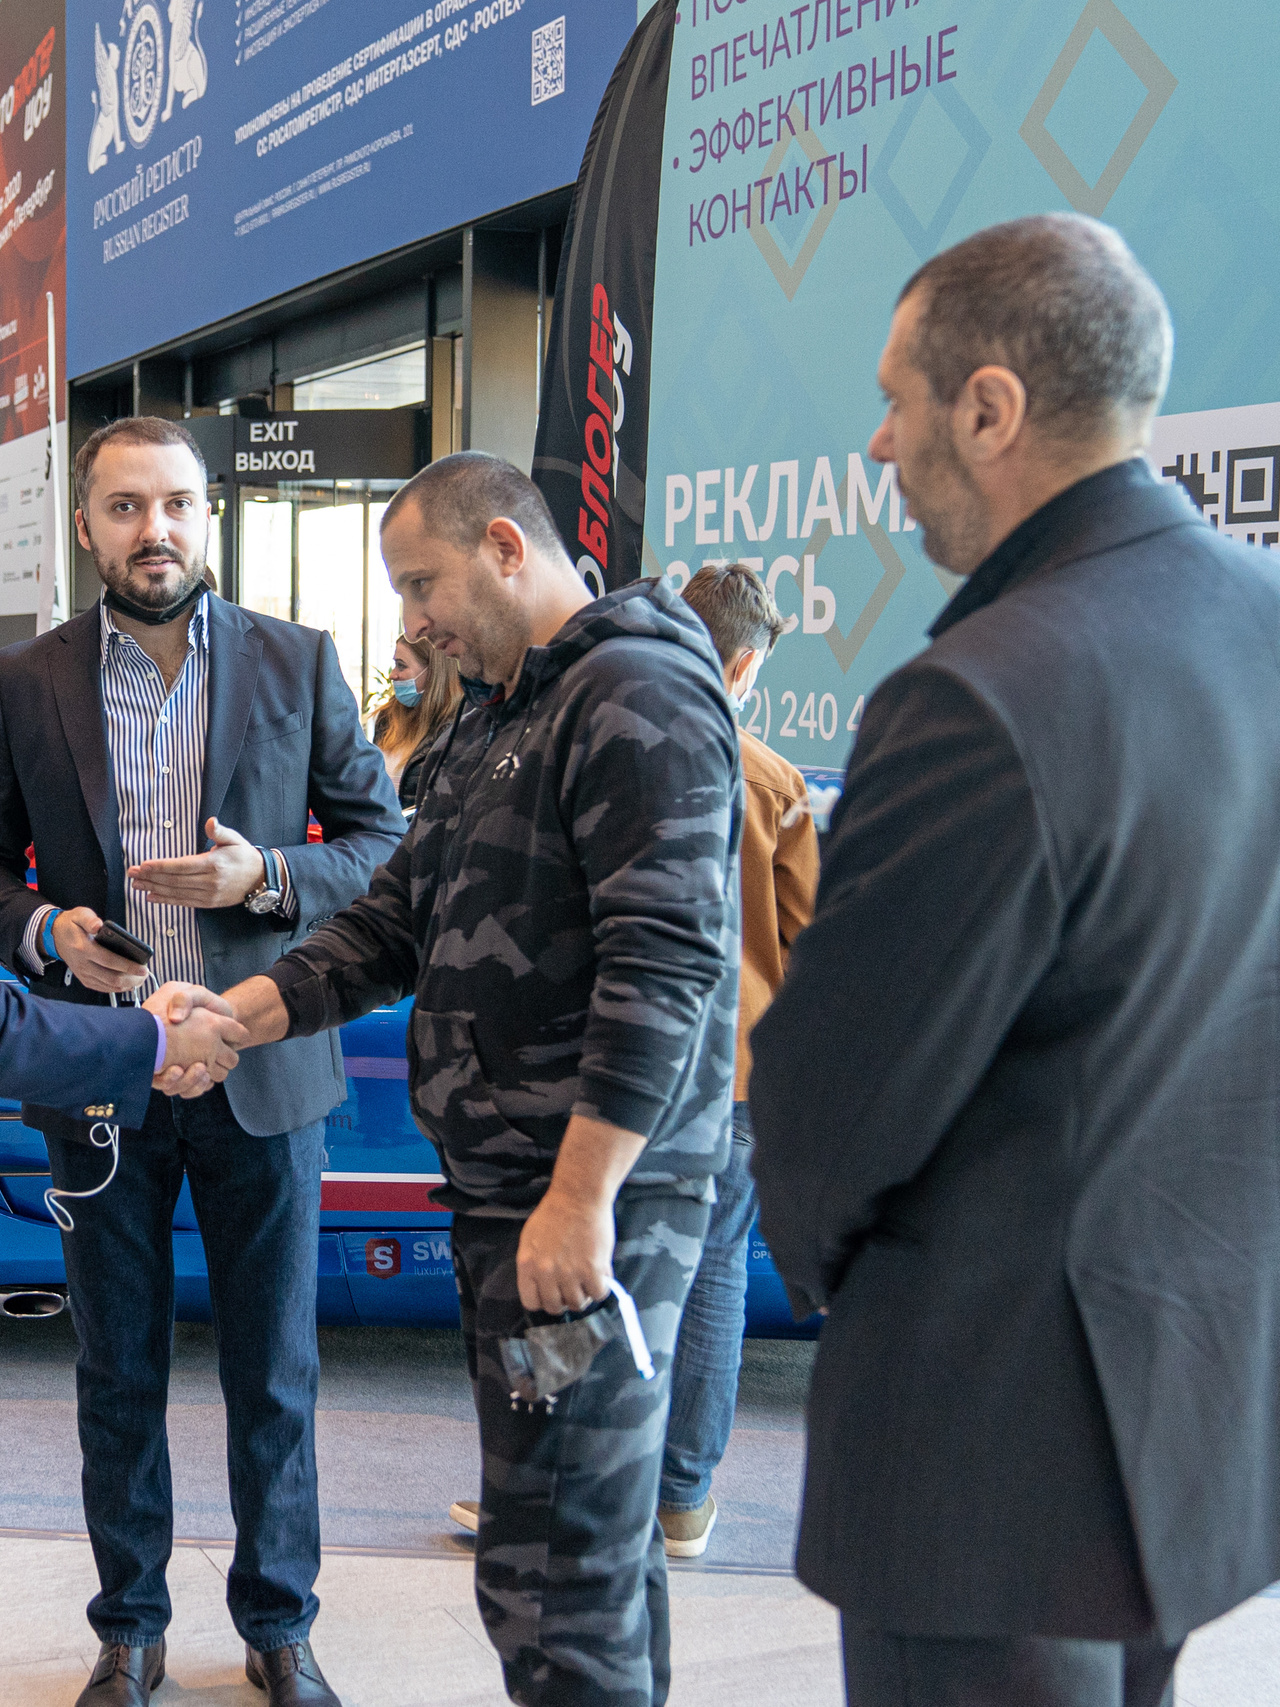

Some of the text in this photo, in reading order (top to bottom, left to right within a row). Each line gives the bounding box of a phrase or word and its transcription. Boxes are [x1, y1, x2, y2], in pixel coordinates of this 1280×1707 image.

[290, 90, 302, 110] НА
[302, 57, 353, 103] ПРОВЕДЕНИЕ
[353, 13, 424, 71] СЕРТИФИКАЦИИ
[426, 9, 433, 29] В
[344, 78, 364, 107] СДС
[365, 33, 443, 95] ИНТЕРГАЗСЕРТ,
[444, 19, 468, 51] СДС
[691, 0, 922, 101] ВПЕЧАТЛЕН
[689, 25, 958, 173] ЭФФЕКТИВНЫЕ
[146, 135, 202, 198] РЕГИСТР
[689, 143, 868, 247] КОНТАКТЫ
[103, 222, 141, 264] RUSSIAN
[141, 193, 190, 243] REGISTER
[235, 449, 316, 473] ВЫХОД
[250, 421, 299, 442] EXIT
[665, 452, 917, 547] РЕКЛАМ
[780, 690, 838, 741] 240
